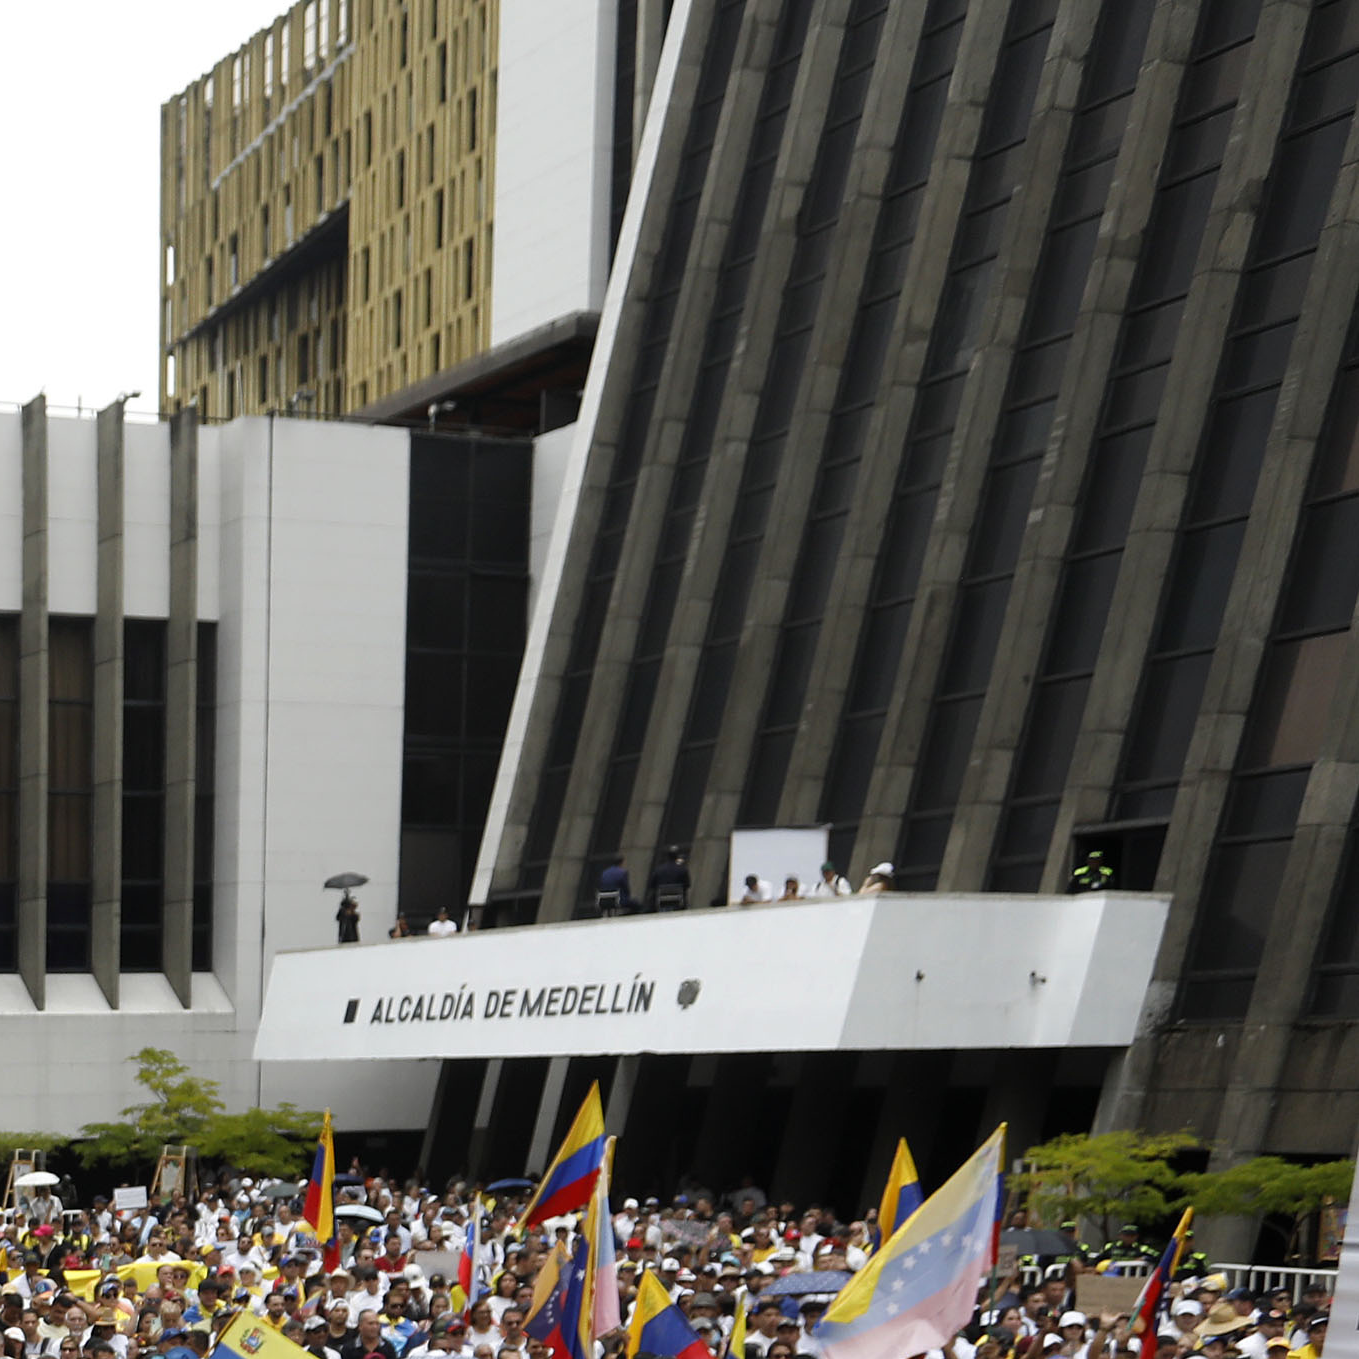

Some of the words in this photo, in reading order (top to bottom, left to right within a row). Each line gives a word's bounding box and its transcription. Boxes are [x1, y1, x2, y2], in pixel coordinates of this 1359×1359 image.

[370, 984, 474, 1023] ALCALDÍA
[483, 990, 515, 1018] DE
[519, 973, 655, 1016] MEDELLÍN
